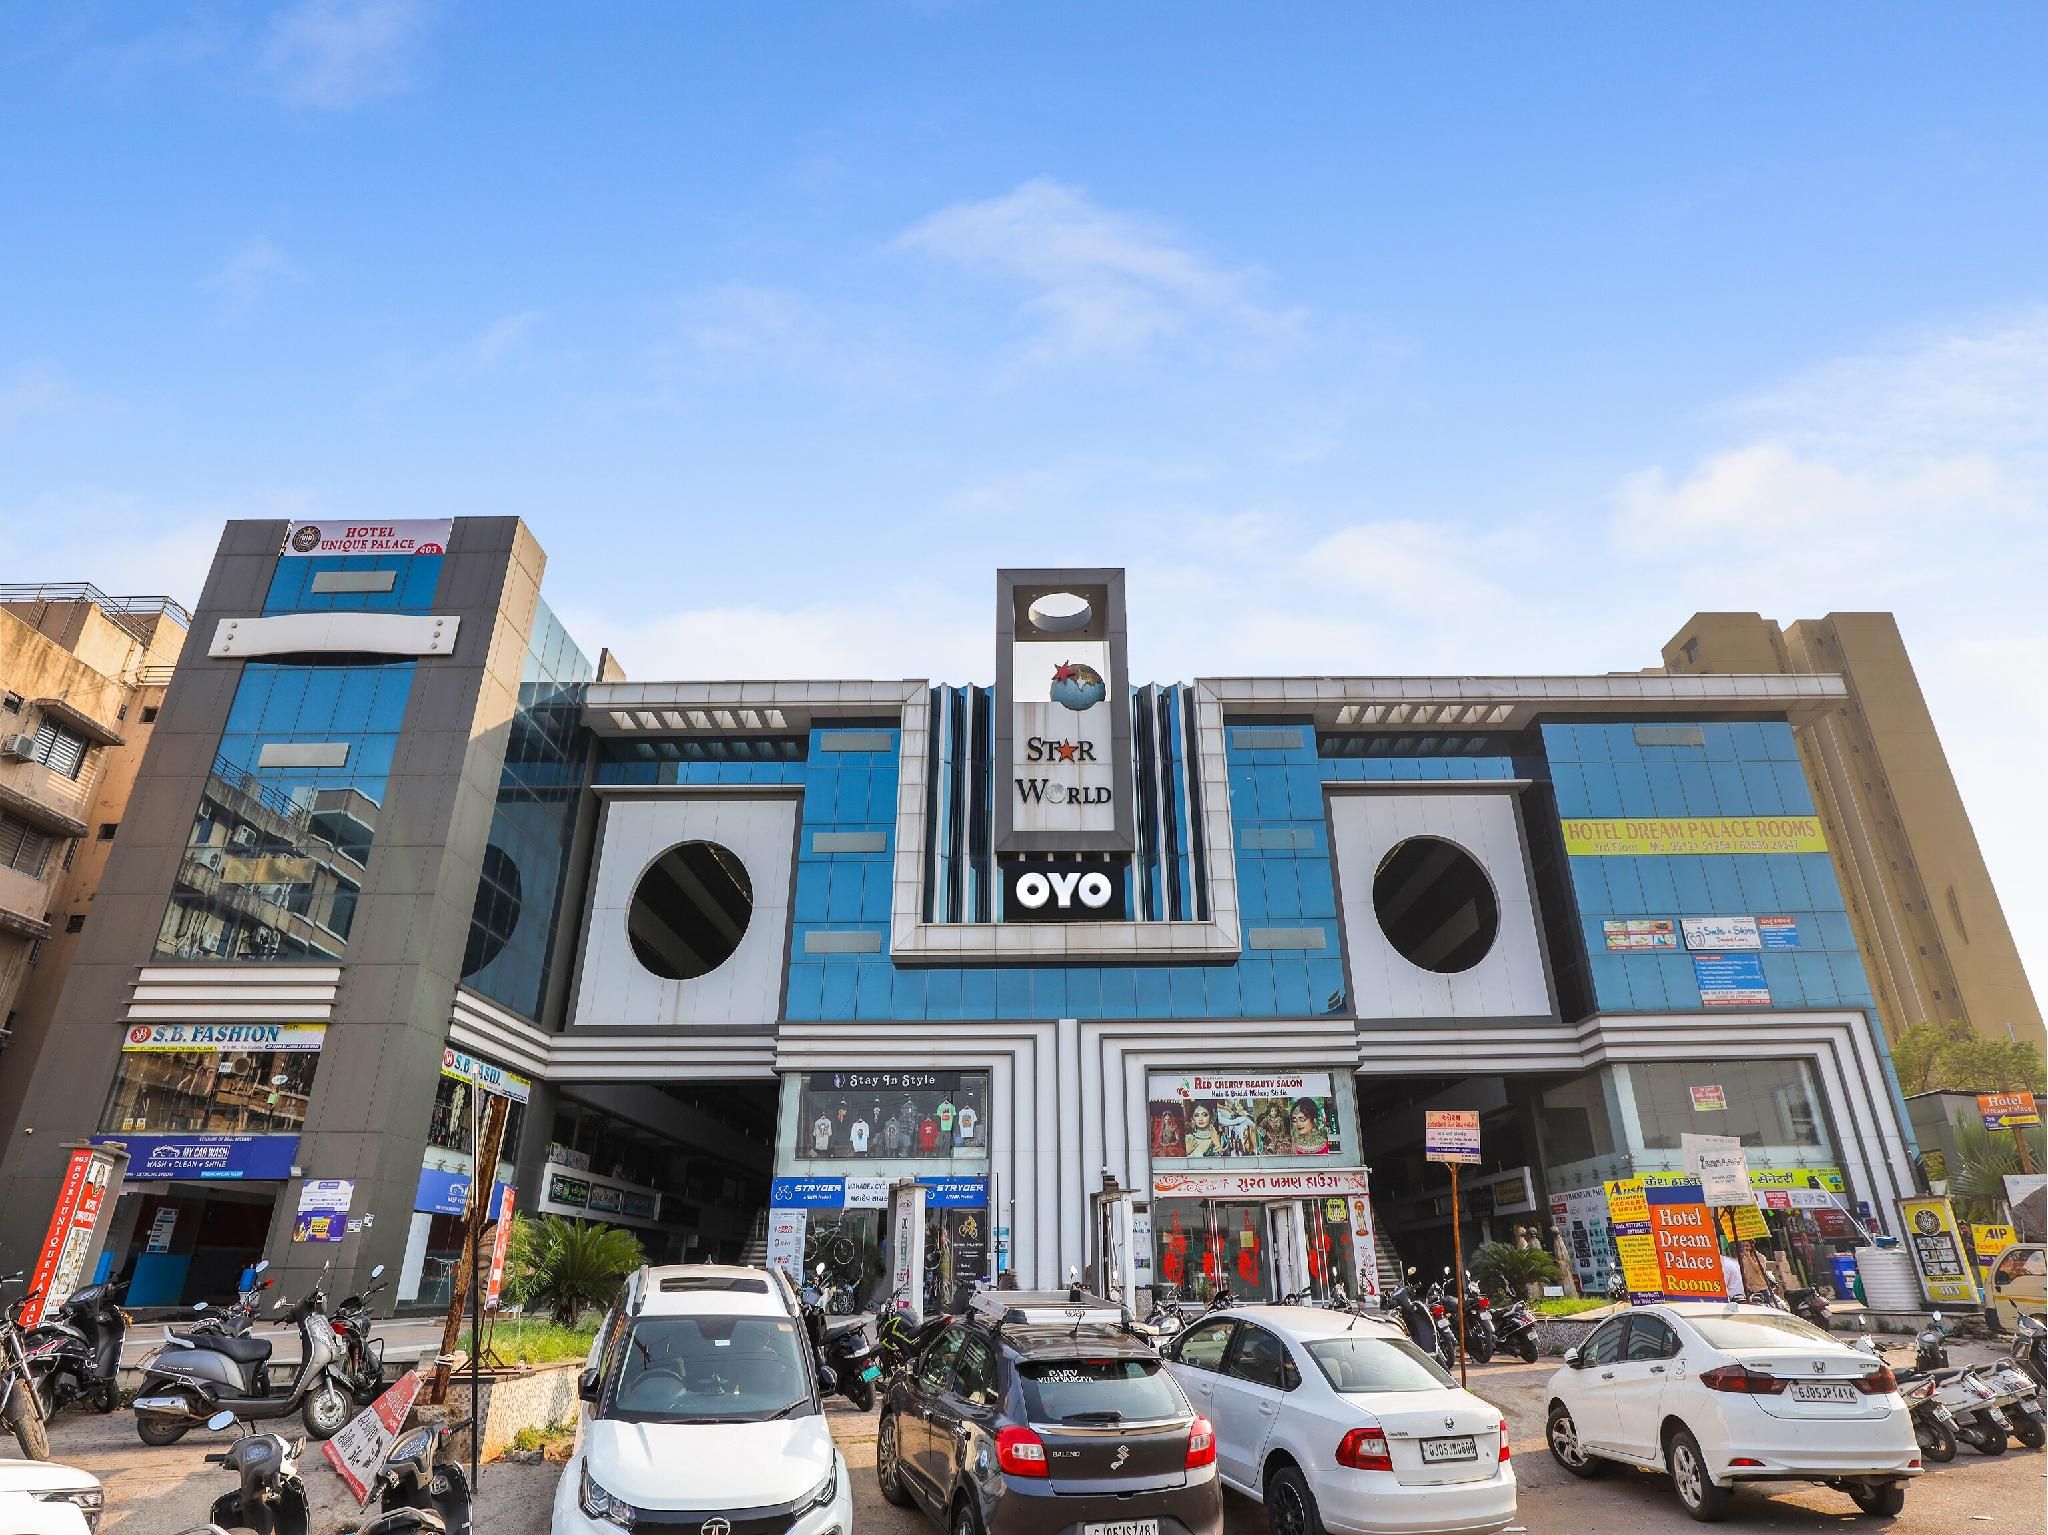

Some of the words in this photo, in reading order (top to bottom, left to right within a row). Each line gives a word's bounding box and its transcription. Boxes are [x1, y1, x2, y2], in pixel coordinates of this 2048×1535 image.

[345, 527, 396, 538] HOTEL
[320, 539, 368, 552] UNIQUE
[371, 539, 416, 549] PALACE
[420, 546, 438, 554] 403
[1014, 779, 1112, 804] WORLD
[1567, 823, 1622, 840] HOTEL
[1625, 822, 1685, 840] DREAM
[1688, 821, 1753, 838] PALACE
[1756, 820, 1817, 838] ROOMS
[1593, 842, 1610, 852] 3rd
[1612, 842, 1639, 852] Floor
[1016, 872, 1112, 909] OYO
[153, 1026, 187, 1042] S.B.
[191, 1026, 280, 1042] FASHION
[850, 1074, 879, 1087] Stay
[902, 1074, 936, 1087] Style
[1194, 1077, 1213, 1090] RED
[1214, 1080, 1244, 1089] CHERRY
[1245, 1080, 1275, 1089] BEAUTY
[1276, 1079, 1303, 1088] SALON
[1987, 1094, 2024, 1107] Hotel
[1984, 1107, 2008, 1115] Dream
[182, 1147, 193, 1158] MY
[194, 1147, 208, 1158] CAR
[208, 1147, 229, 1158] WASH
[64, 1166, 82, 1204] HOTEL
[795, 1184, 842, 1192] STRYDER
[936, 1184, 984, 1192] STRYDER
[1237, 1177, 1266, 1192] સુરત
[1270, 1177, 1302, 1189] ખમણ
[1658, 1208, 1703, 1227] Hotel
[43, 1207, 70, 1269] UNIQUE
[1658, 1229, 1712, 1248] Dream
[1984, 1228, 2007, 1242] AIP
[1664, 1251, 1714, 1270] Palace
[1665, 1275, 1722, 1292] Rooms
[1048, 1369, 1079, 1377] PARV
